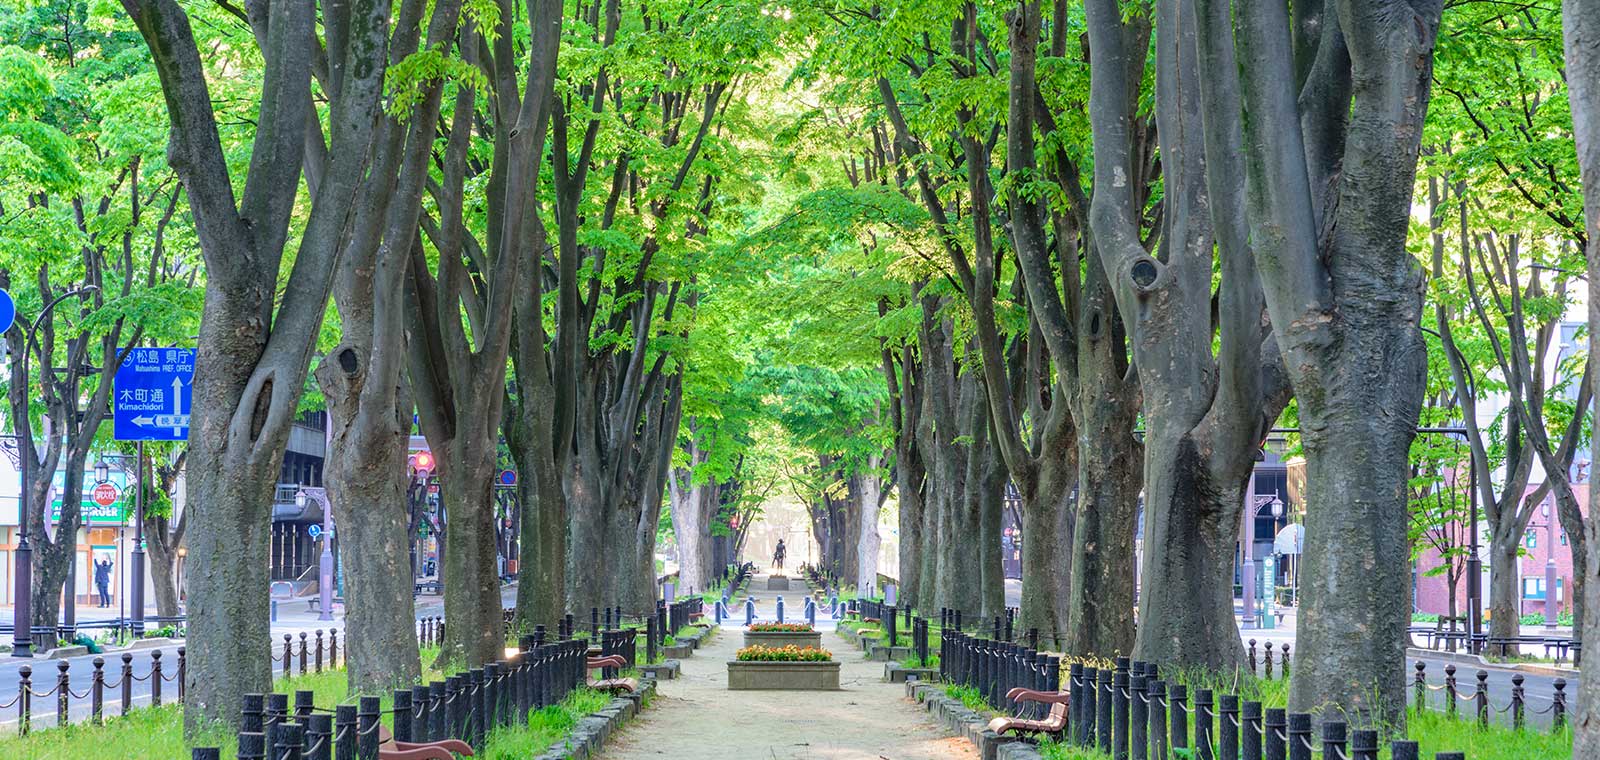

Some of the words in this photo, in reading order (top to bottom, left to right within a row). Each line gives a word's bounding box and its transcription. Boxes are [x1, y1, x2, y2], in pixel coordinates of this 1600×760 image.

[136, 349, 159, 364] 松島
[166, 349, 189, 364] 県庁
[176, 364, 192, 372] OFFICE
[120, 388, 164, 403] 木町通
[119, 402, 164, 411] Kimachidori
